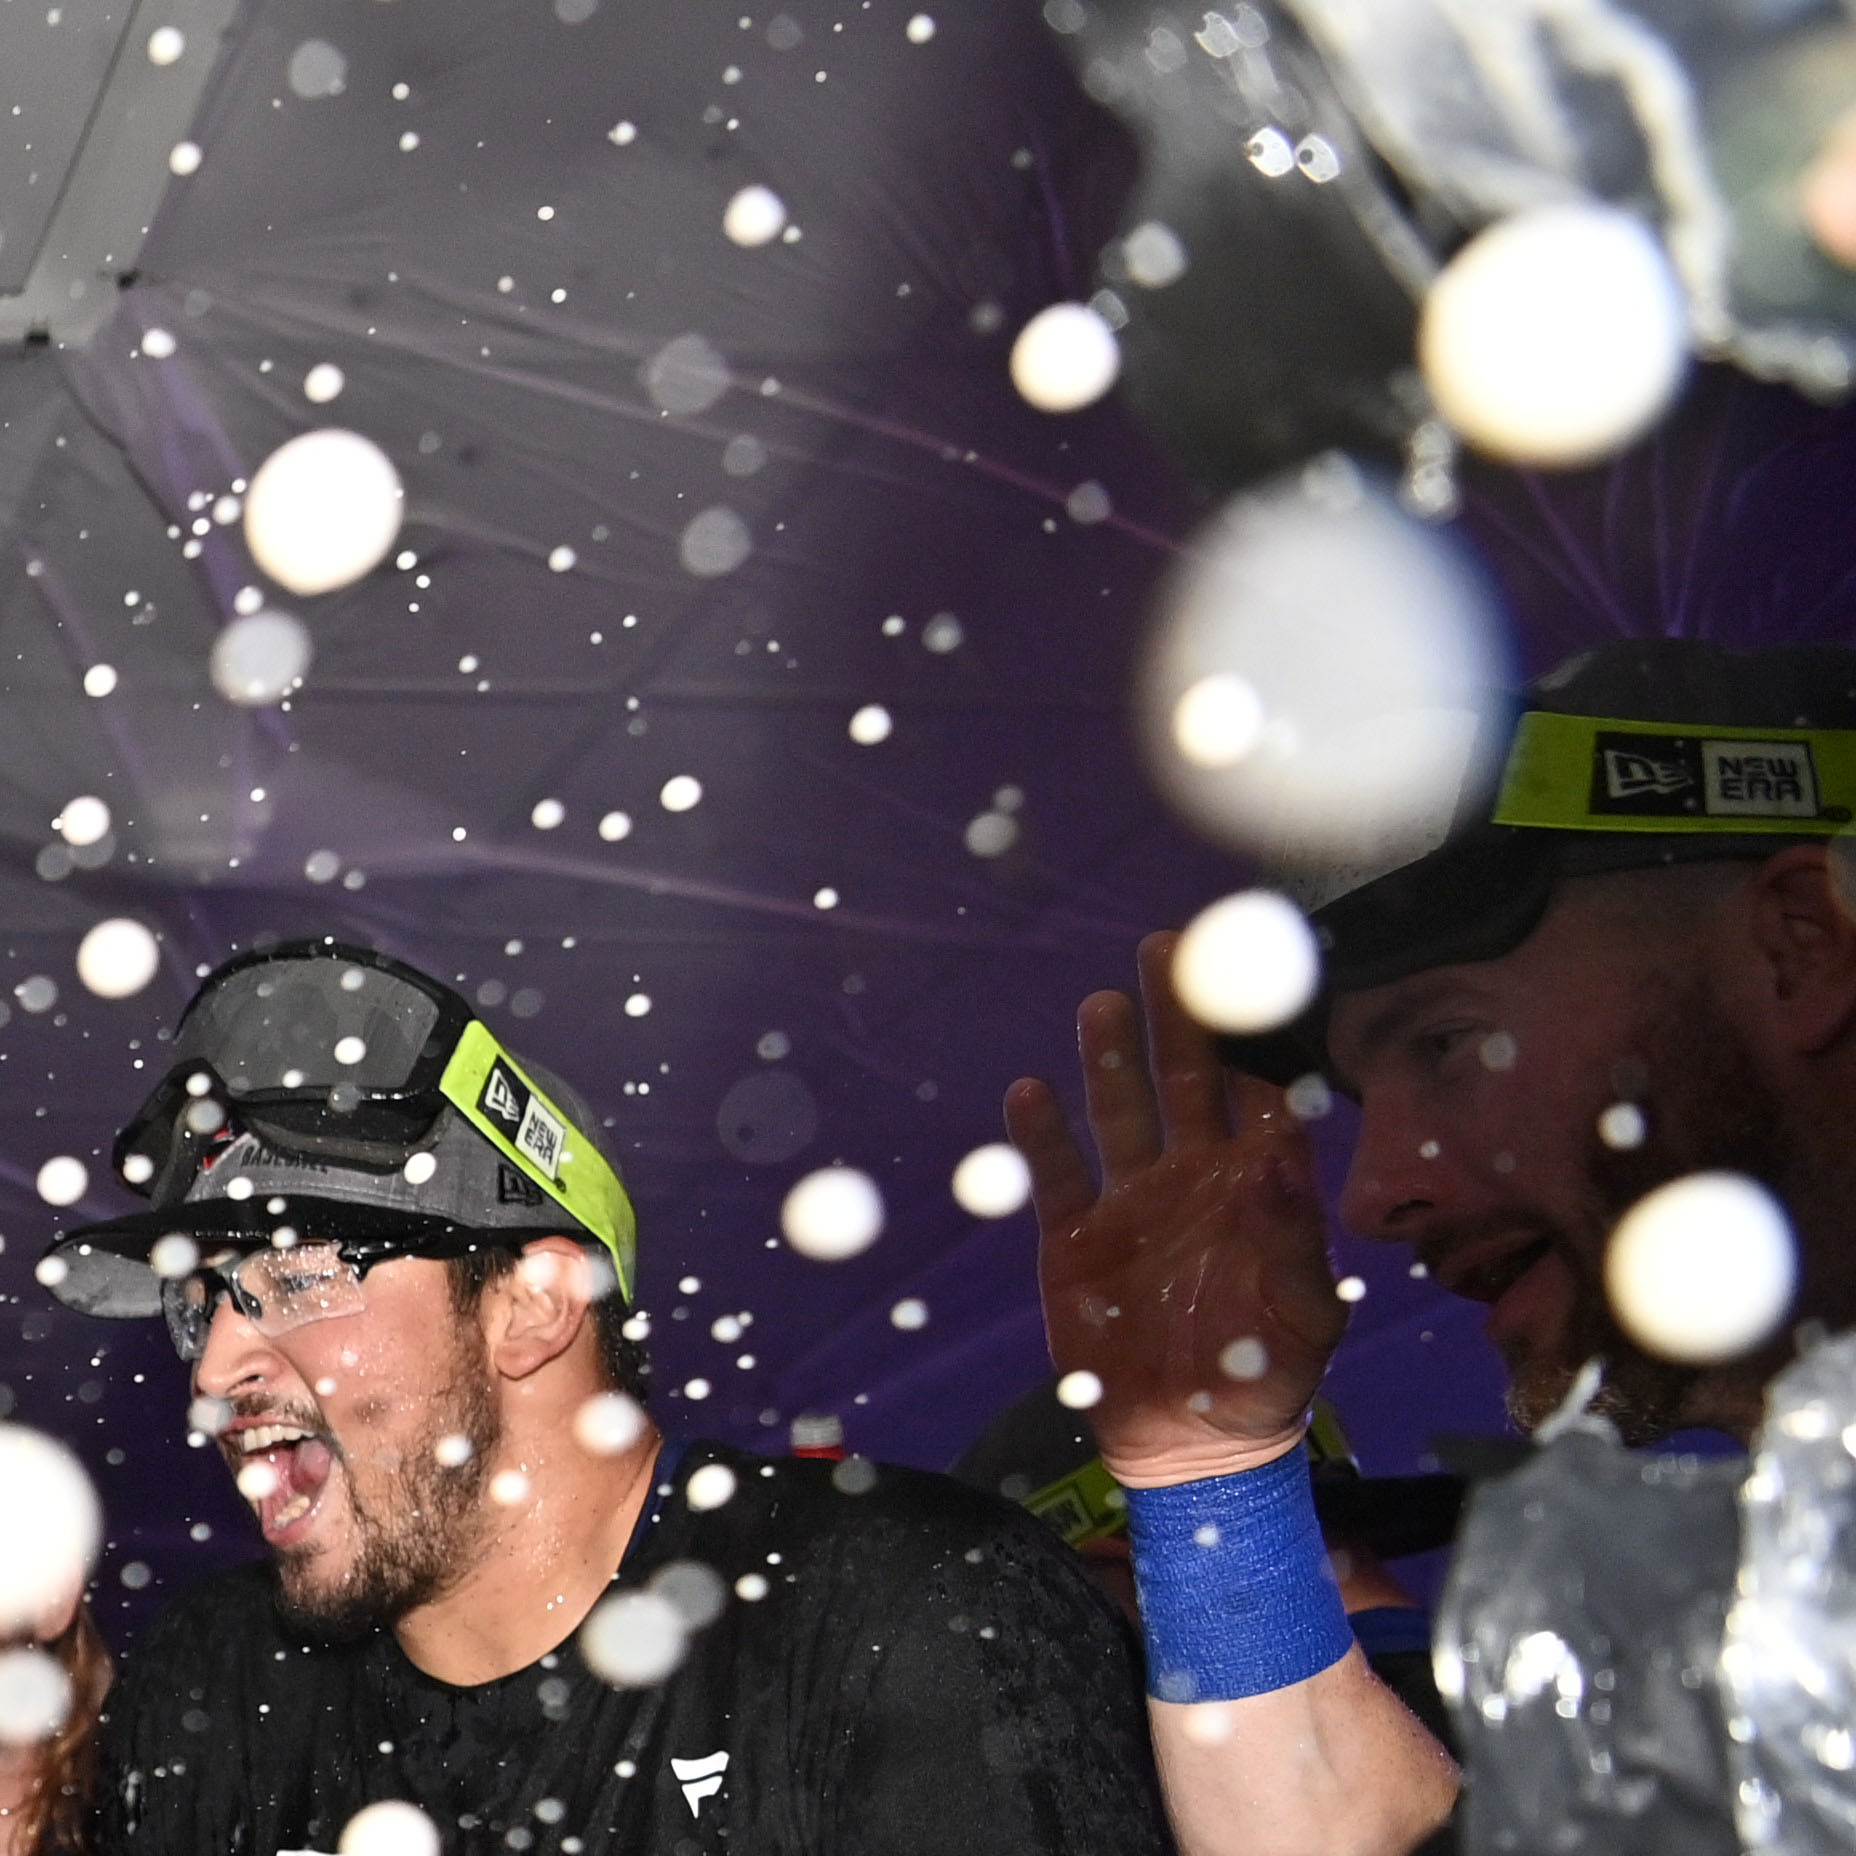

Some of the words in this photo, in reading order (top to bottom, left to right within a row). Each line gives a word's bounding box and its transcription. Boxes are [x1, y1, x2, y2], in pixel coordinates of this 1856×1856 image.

[1718, 755, 1797, 778] NEW
[1720, 777, 1802, 801] ERA
[529, 1111, 559, 1149] NEW
[523, 1126, 555, 1166] ERA
